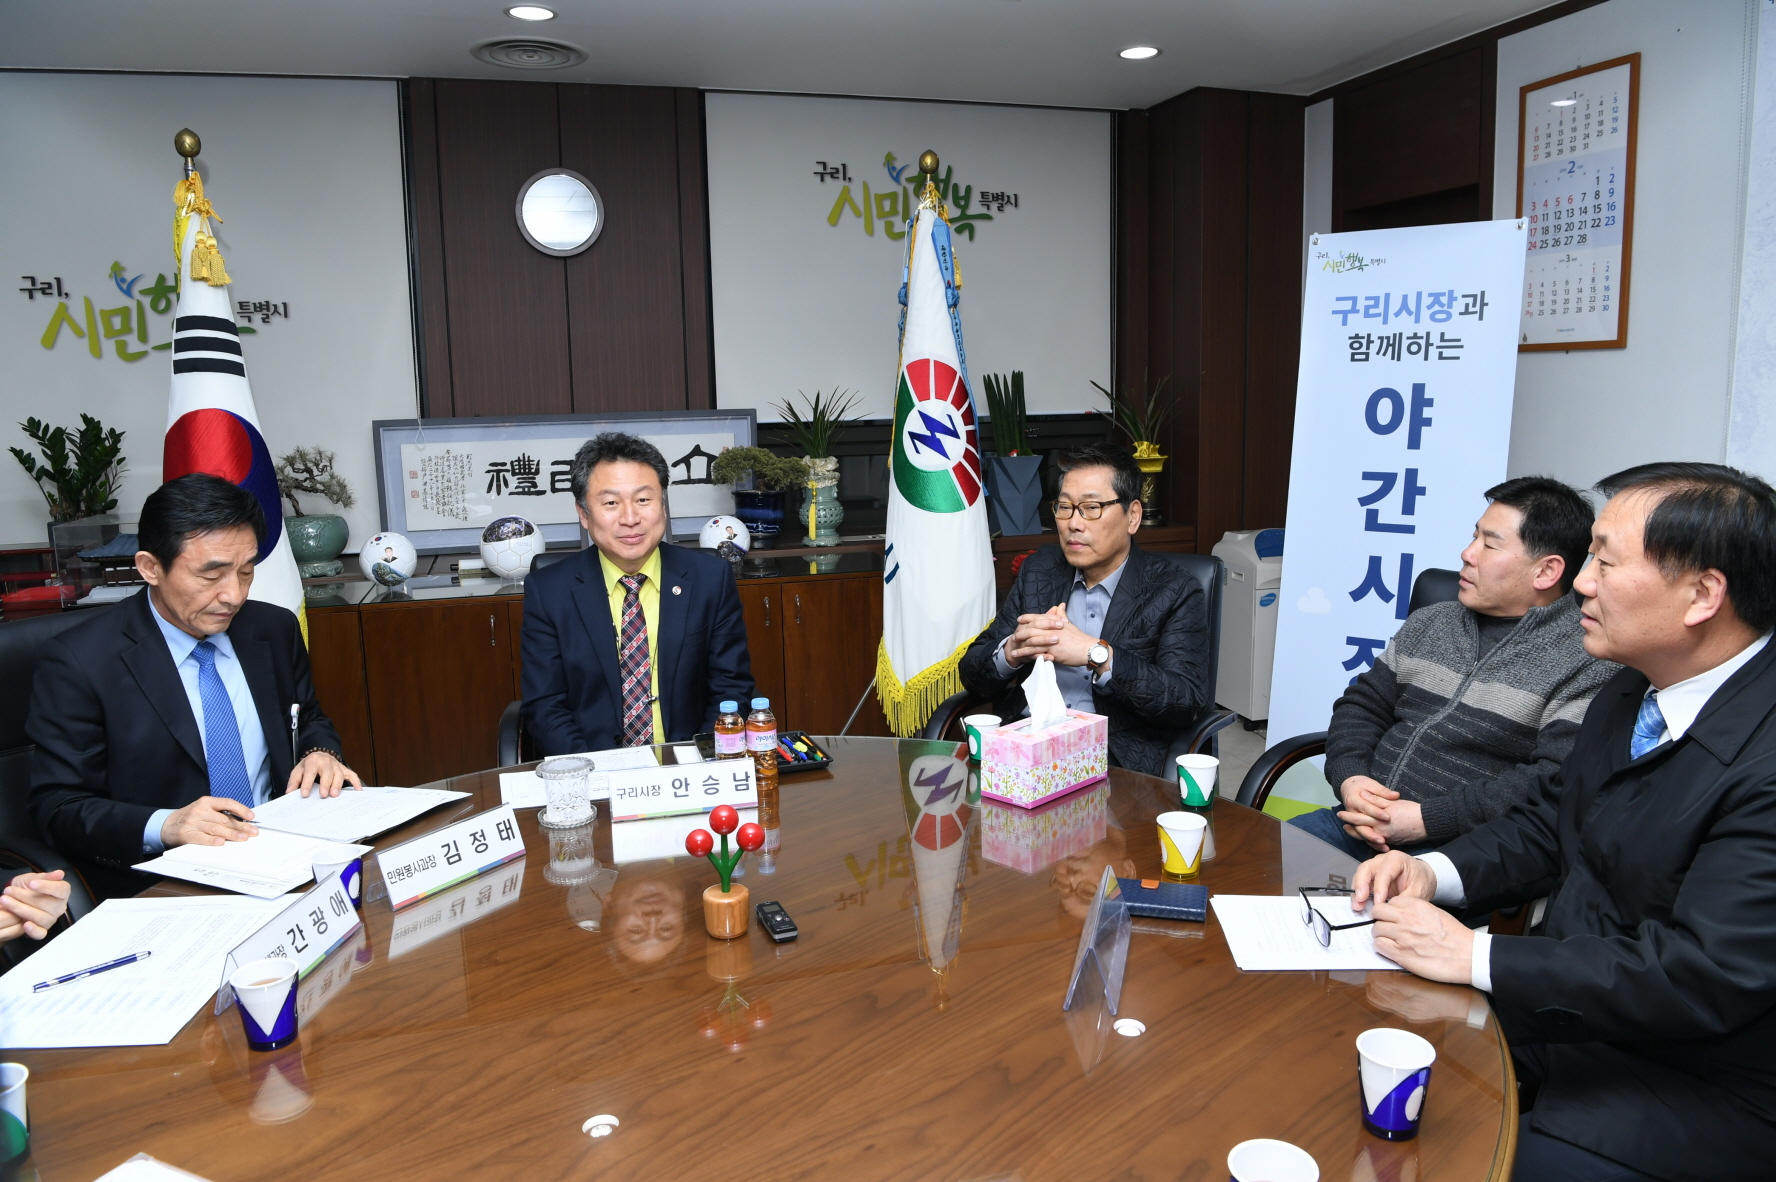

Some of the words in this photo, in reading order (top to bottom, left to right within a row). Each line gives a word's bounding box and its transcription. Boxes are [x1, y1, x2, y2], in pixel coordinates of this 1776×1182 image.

[1574, 91, 1577, 99] 1
[1611, 126, 1618, 134] 26
[1568, 161, 1575, 174] 2
[813, 161, 852, 182] 구리,
[978, 191, 1018, 211] 특별시
[1596, 176, 1599, 185] 1
[1609, 174, 1614, 183] 2
[1532, 202, 1536, 210] 3
[1543, 200, 1548, 208] 4
[1556, 197, 1560, 206] 5
[1568, 195, 1573, 204] 6
[1581, 192, 1586, 202] 7
[1595, 190, 1600, 199] 8
[1609, 188, 1614, 197] 9
[1530, 215, 1538, 224] 10
[1542, 213, 1548, 222] 11
[1554, 211, 1561, 220] 12
[1566, 208, 1574, 218] 13
[1579, 206, 1587, 216] 14
[1593, 204, 1601, 214] 15
[1607, 202, 1616, 211] 16
[1530, 228, 1537, 237] 17
[1542, 226, 1549, 235] 18
[1554, 224, 1561, 233] 19
[1565, 222, 1574, 232] 20
[1578, 220, 1586, 230] 21
[1591, 218, 1601, 228] 22
[1605, 216, 1615, 226] 23
[1528, 241, 1537, 250] 24
[1540, 239, 1548, 249] 25
[1552, 238, 1560, 247] 26
[1564, 236, 1573, 245] 27
[1577, 234, 1587, 244] 28
[1322, 252, 1369, 273] 시민행복
[1566, 254, 1570, 262] 3
[19, 275, 69, 300] 구리,
[236, 300, 289, 324] 특별시
[1332, 289, 1489, 326] 구리시장과
[1348, 331, 1464, 362] 함께하는
[616, 784, 661, 800] 구리시장
[387, 854, 437, 885] 민원봉사과장
